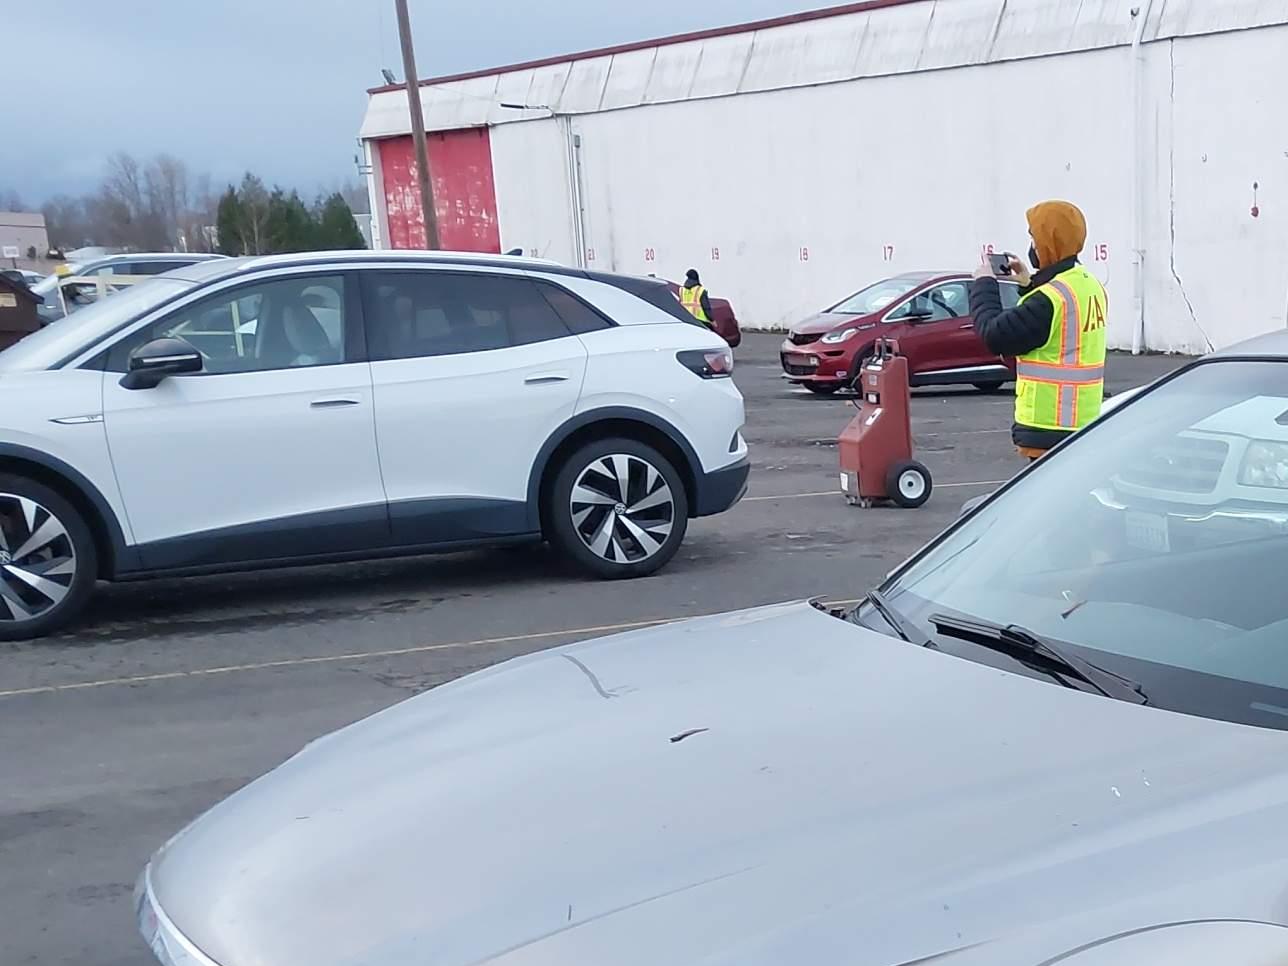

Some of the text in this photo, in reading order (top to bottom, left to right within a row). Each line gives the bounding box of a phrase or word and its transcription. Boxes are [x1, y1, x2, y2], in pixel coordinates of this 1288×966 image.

[645, 247, 655, 261] 20
[799, 247, 809, 261] 18
[883, 245, 894, 261] 17
[1094, 244, 1108, 261] 15
